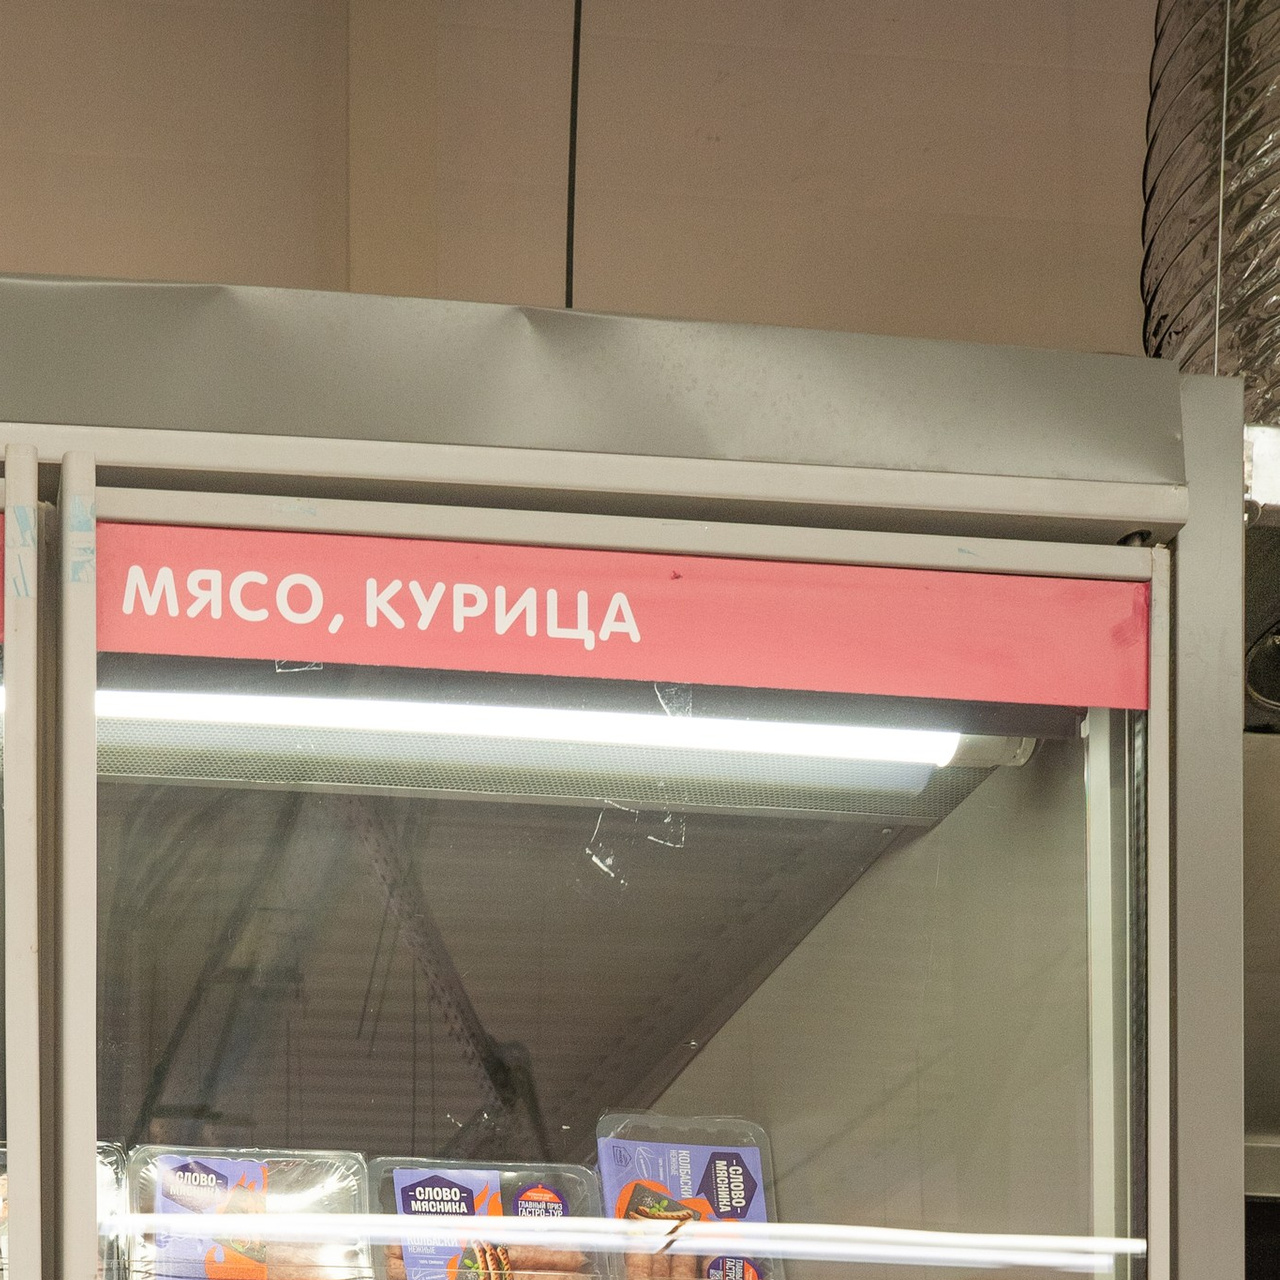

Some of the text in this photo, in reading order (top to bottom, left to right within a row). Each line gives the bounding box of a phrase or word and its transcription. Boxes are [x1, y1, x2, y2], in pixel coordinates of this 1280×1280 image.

[122, 565, 641, 651] МЯСО, КУРИЦА
[411, 1199, 468, 1214] МЯСНИКА
[714, 1160, 732, 1214] МЯСНИКА
